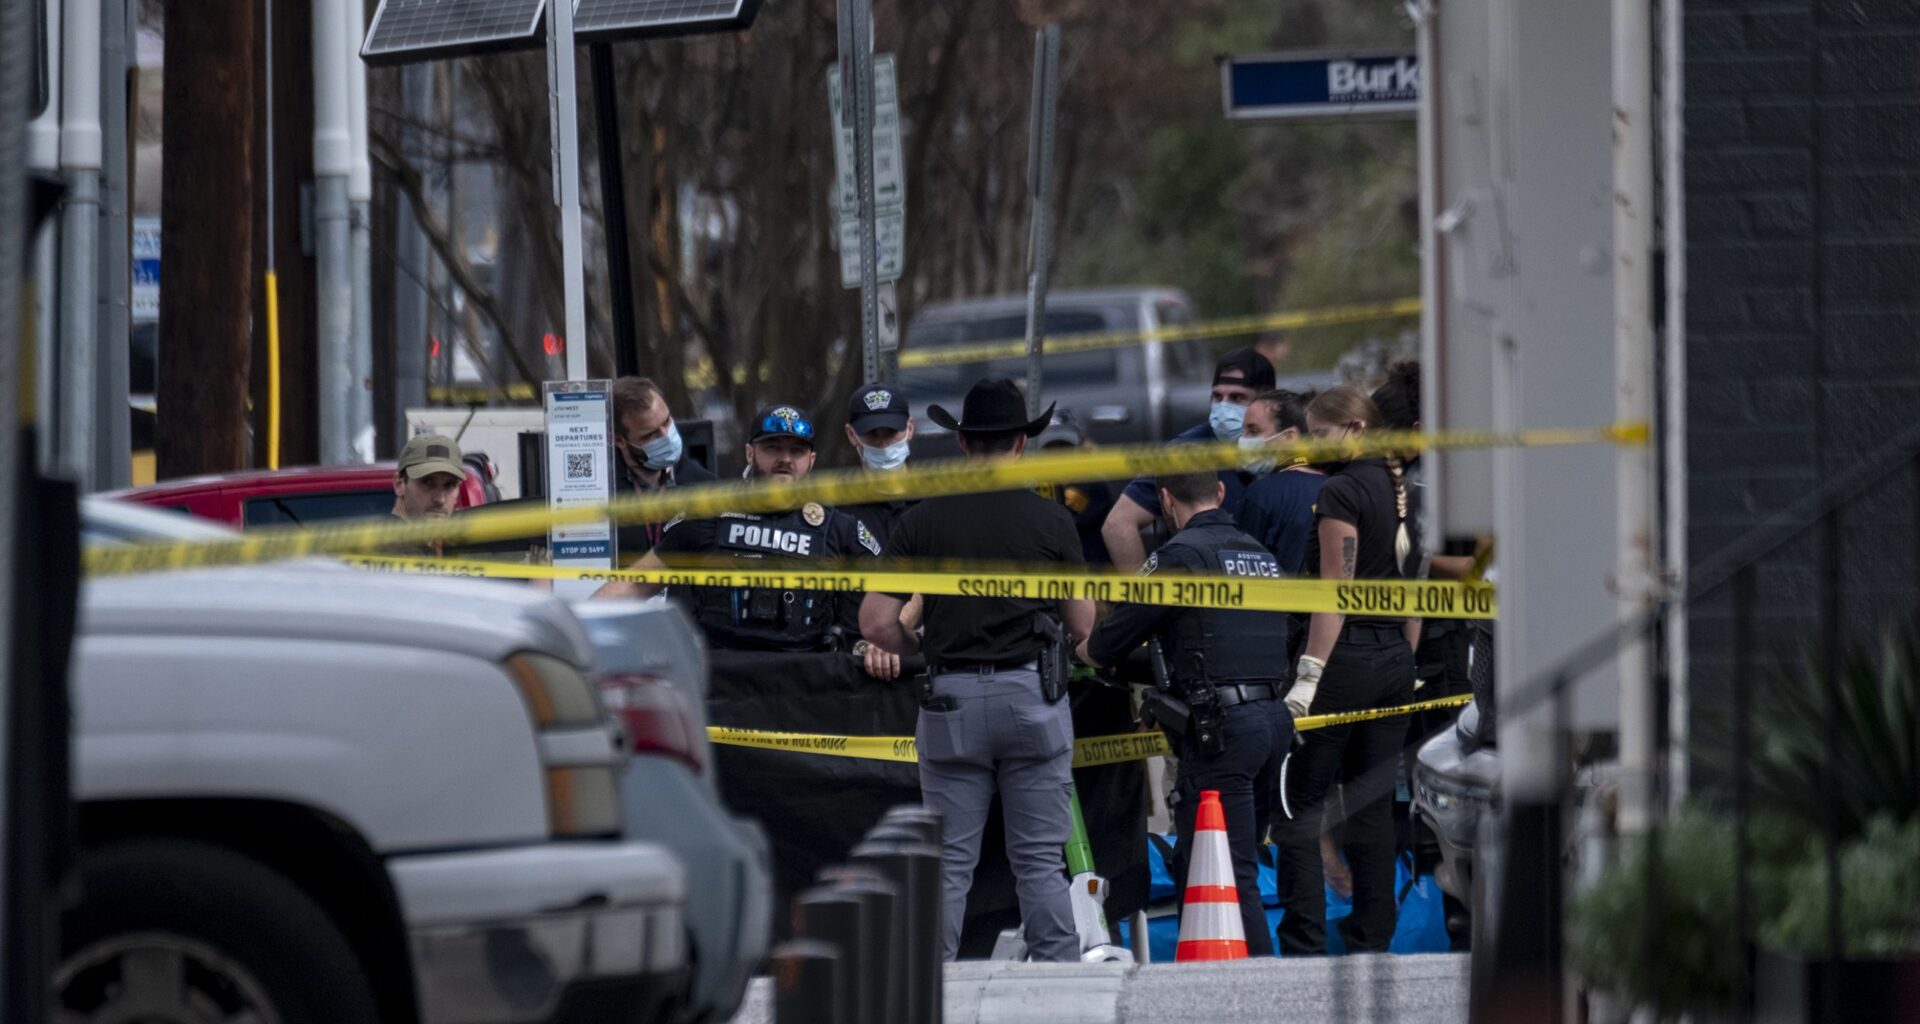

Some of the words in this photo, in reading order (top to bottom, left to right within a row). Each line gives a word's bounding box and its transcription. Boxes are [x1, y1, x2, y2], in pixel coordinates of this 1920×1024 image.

[1327, 58, 1418, 94] Burk
[555, 434, 603, 442] DEPARTURES
[561, 546, 579, 554] STOP
[728, 523, 812, 555] POLICE
[1224, 560, 1279, 577] POLICE
[958, 579, 1026, 597] CROSS
[1084, 580, 1110, 600] DO
[1119, 581, 1163, 603] LINE
[1172, 582, 1244, 606] POLICE
[1336, 584, 1406, 611] CROSS
[1414, 585, 1454, 612] NOT
[1463, 585, 1491, 613] DO
